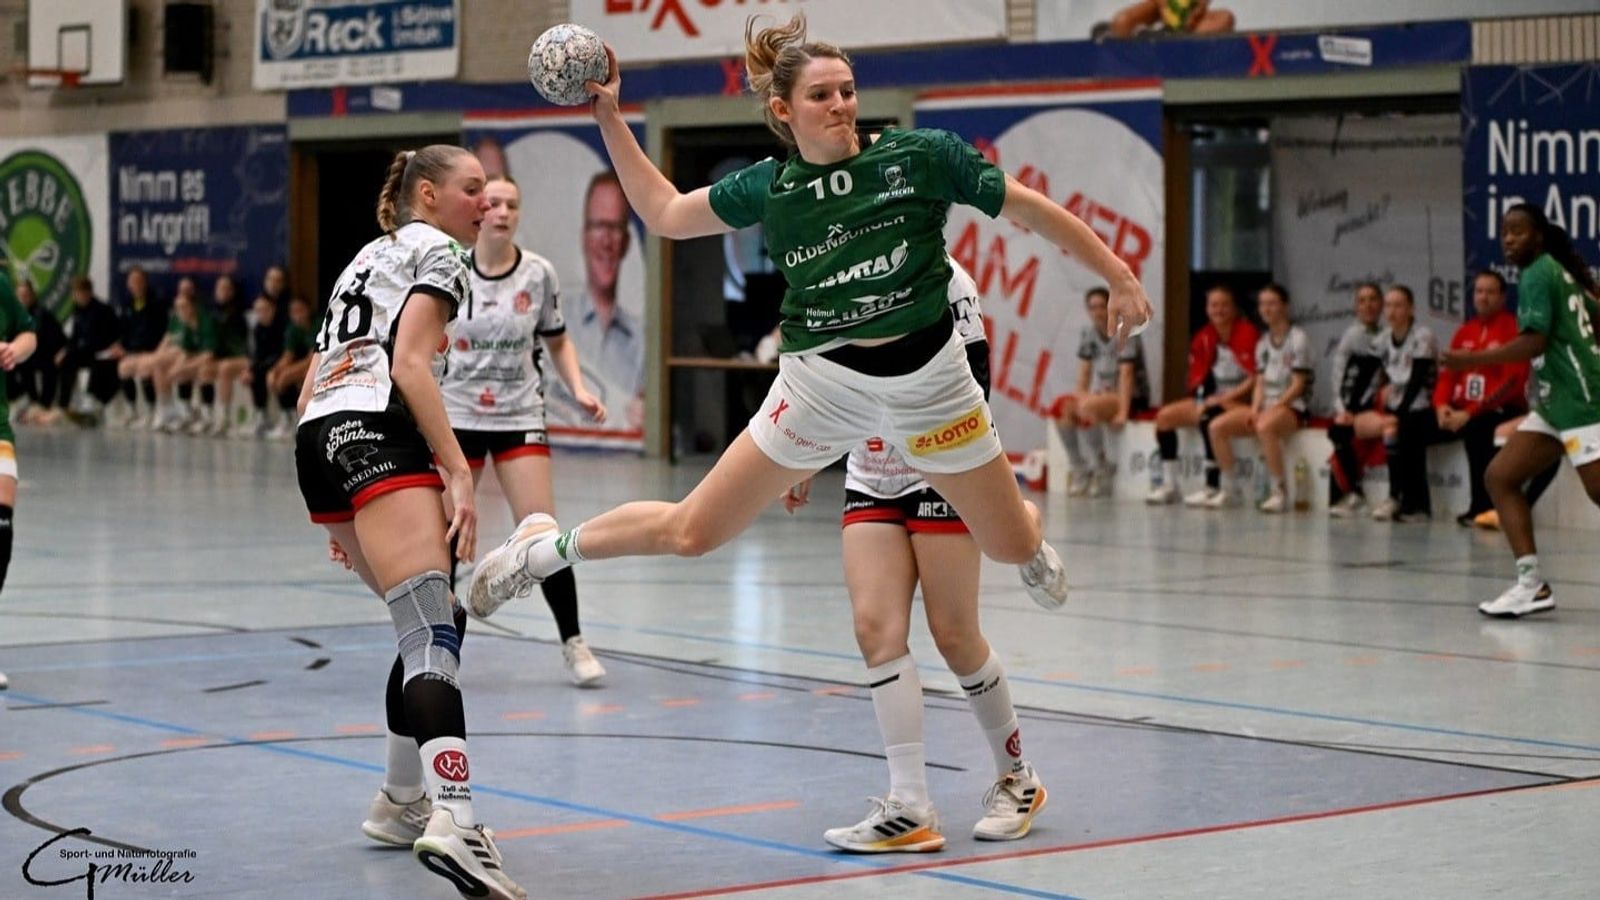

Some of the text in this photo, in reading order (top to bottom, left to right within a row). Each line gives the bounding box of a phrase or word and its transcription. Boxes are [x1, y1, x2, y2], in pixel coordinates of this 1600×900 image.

[304, 11, 384, 51] Reck
[119, 164, 205, 202] Nimm es
[807, 169, 853, 200] 10
[0, 169, 72, 230] EBBE
[118, 212, 138, 243] in
[806, 307, 835, 317] Helmut
[934, 416, 980, 447] LOTTO
[917, 502, 932, 517] AR
